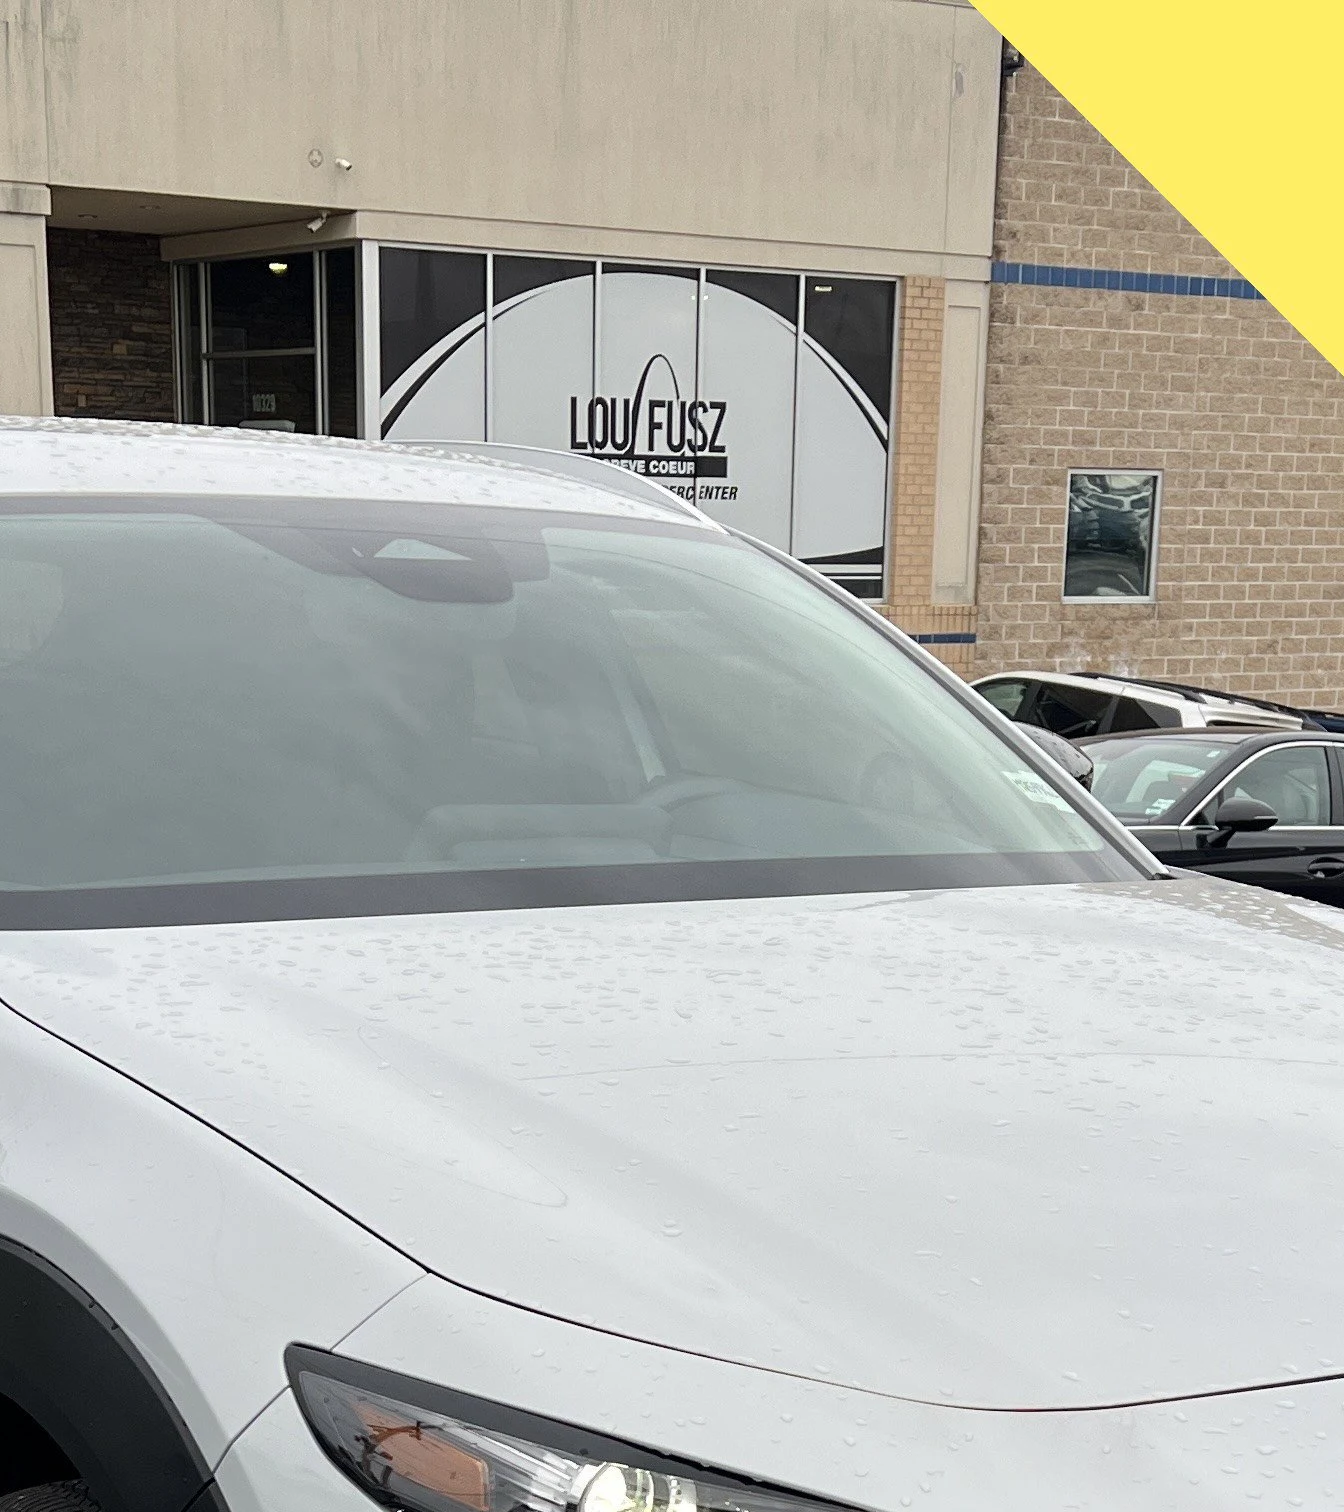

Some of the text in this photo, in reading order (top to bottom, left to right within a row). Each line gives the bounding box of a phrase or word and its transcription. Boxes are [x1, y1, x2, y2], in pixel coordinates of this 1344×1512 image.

[570, 396, 727, 454] LOU FUSZ
[649, 460, 695, 475] COEUR
